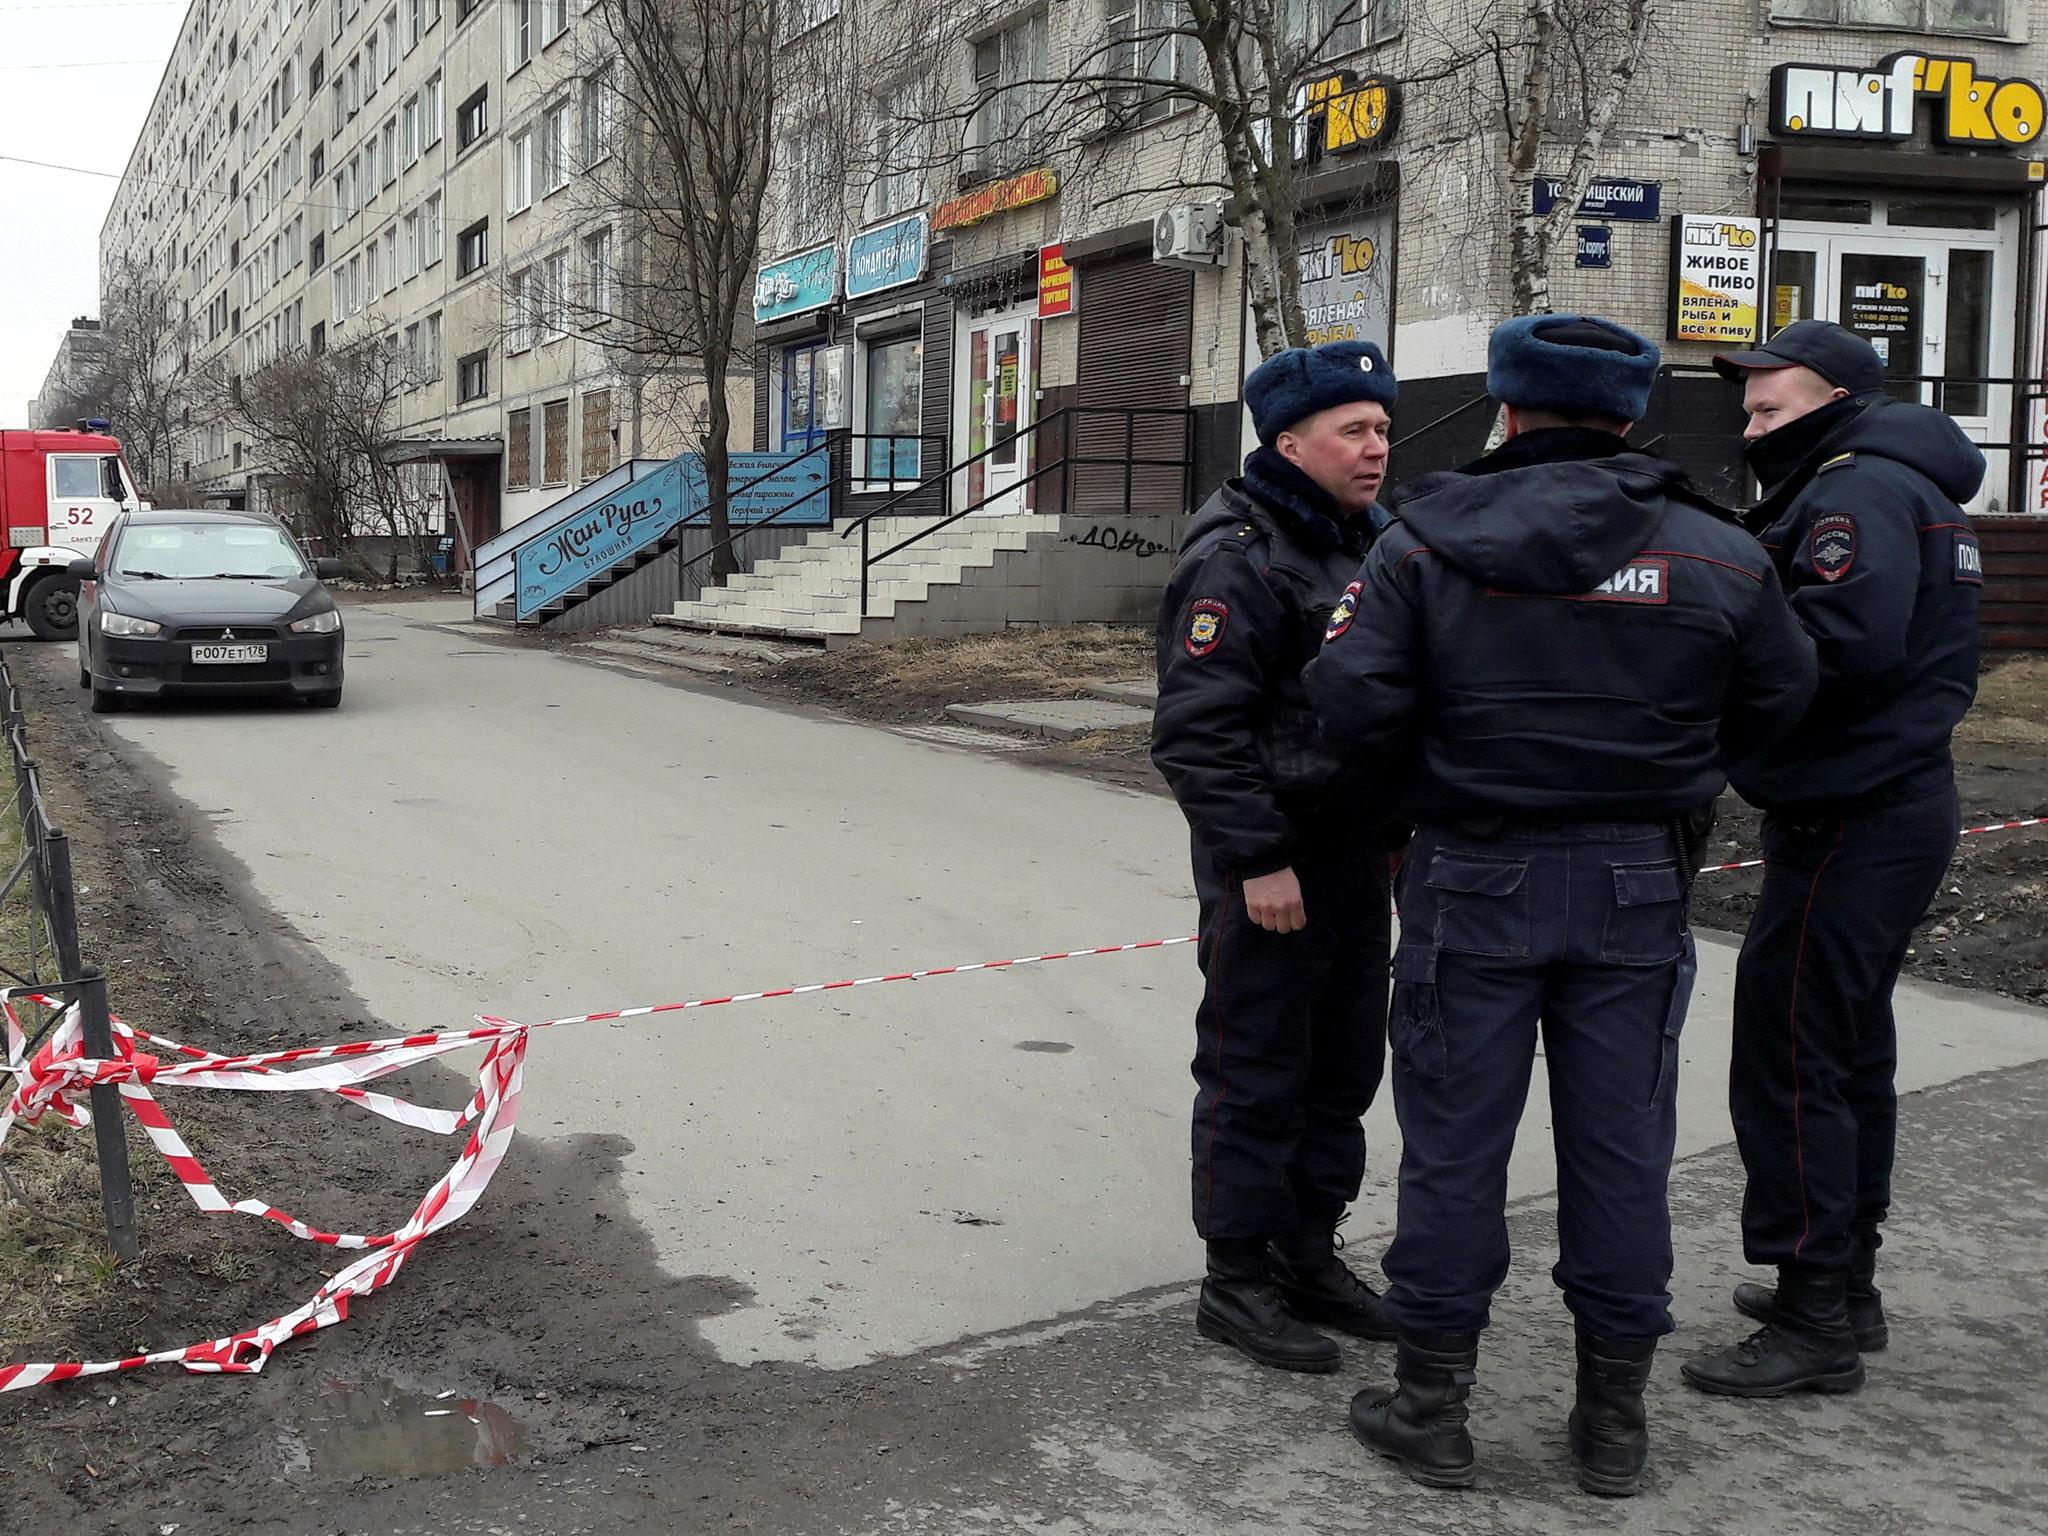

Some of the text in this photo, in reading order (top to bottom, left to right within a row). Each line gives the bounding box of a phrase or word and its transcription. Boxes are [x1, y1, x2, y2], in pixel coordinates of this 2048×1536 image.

[1547, 183, 1644, 204] ТОИЩЕСКИЙ
[1686, 255, 1749, 271] ЖИВОЕ
[1708, 275, 1756, 290] ПИВО
[1682, 297, 1738, 309] ВЯЛЕНАЯ
[1682, 310, 1731, 321] РЫБА И
[1681, 322, 1752, 339] всё к пиву
[68, 507, 93, 525] 52
[539, 498, 662, 575] Жан Руа
[195, 645, 265, 659] Р007ЕТ 178
